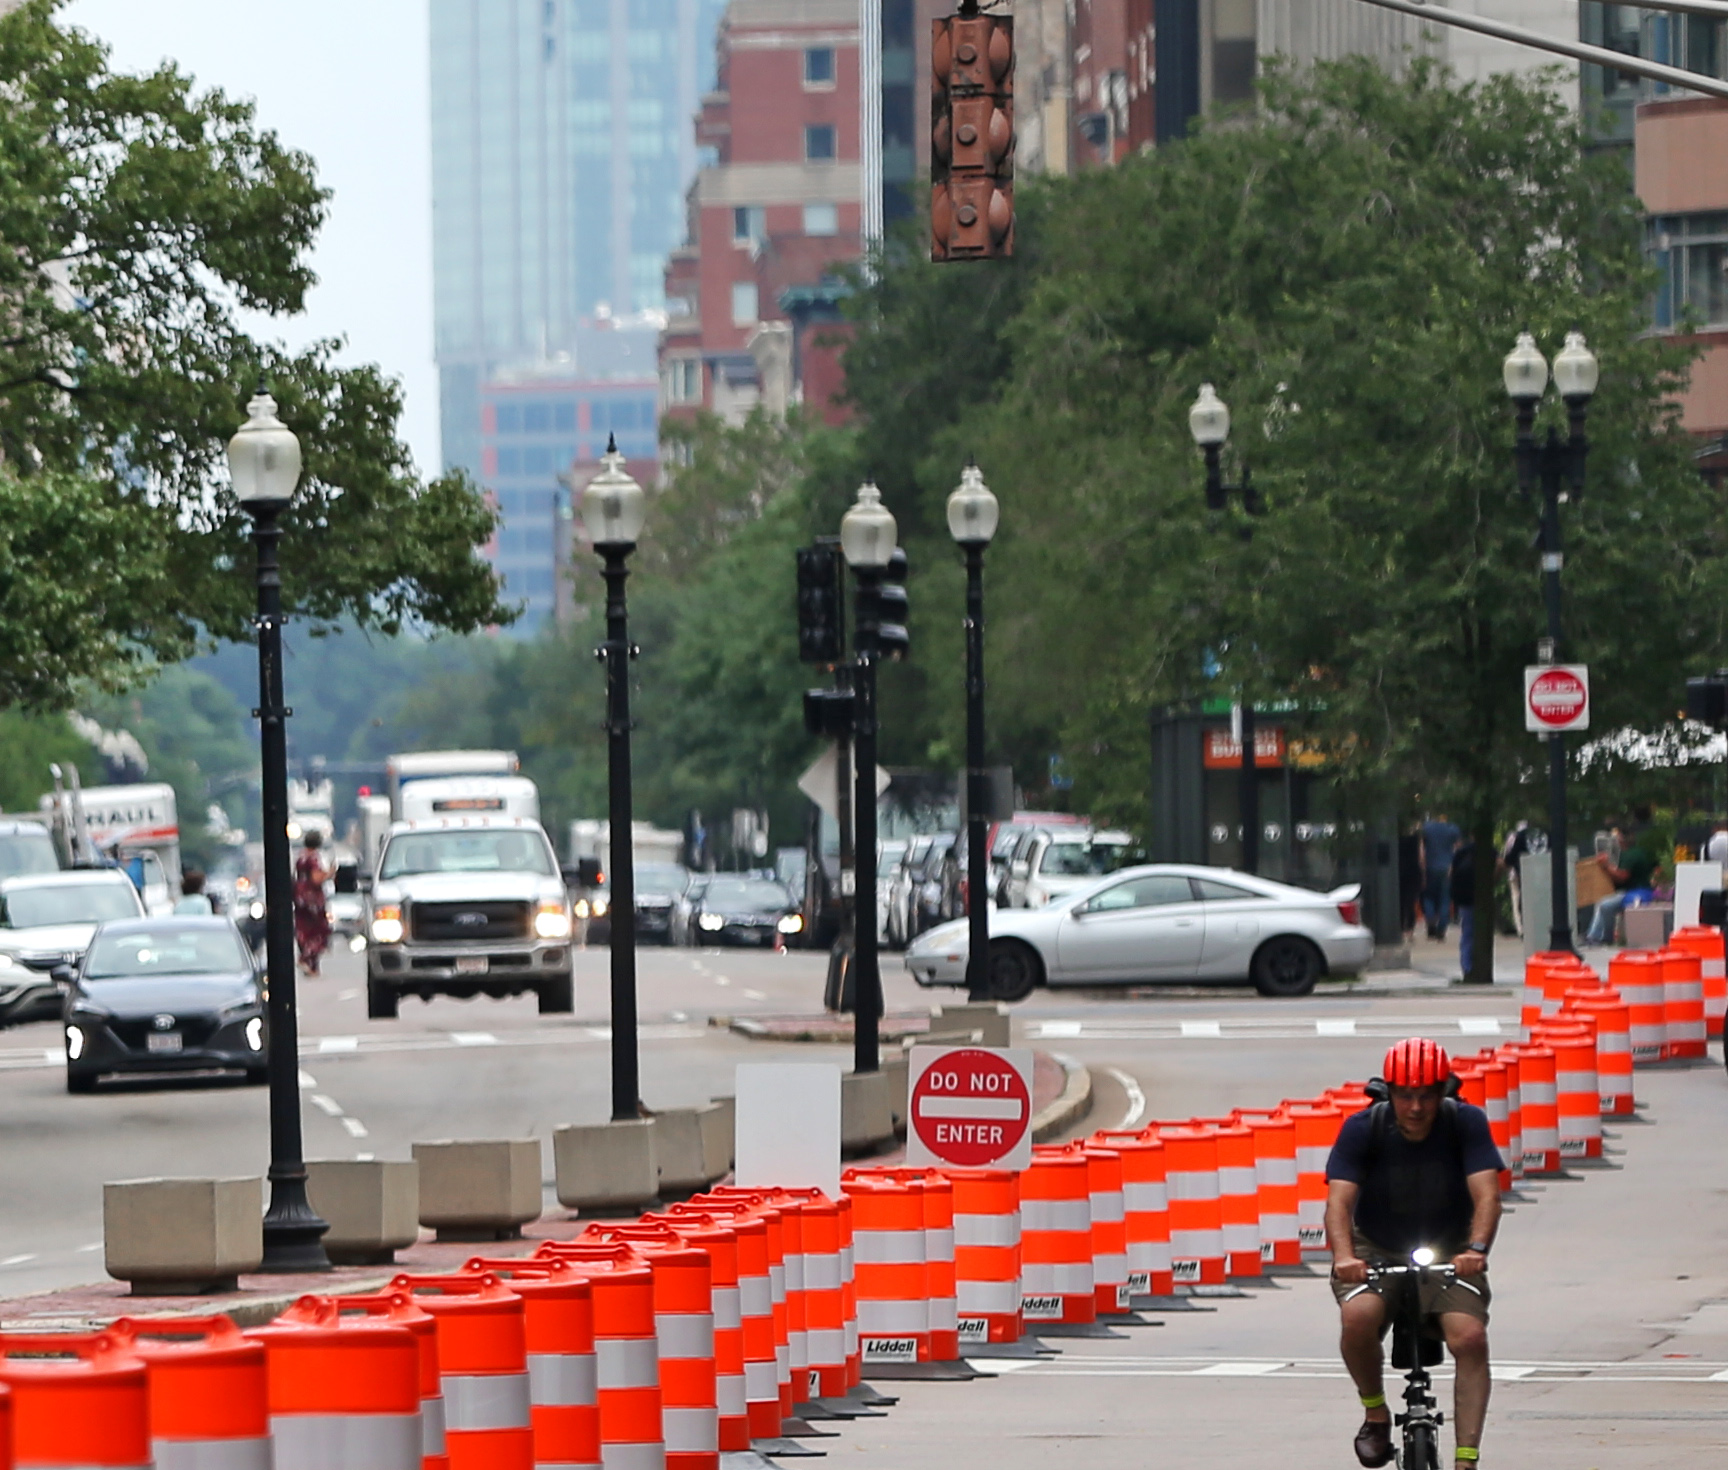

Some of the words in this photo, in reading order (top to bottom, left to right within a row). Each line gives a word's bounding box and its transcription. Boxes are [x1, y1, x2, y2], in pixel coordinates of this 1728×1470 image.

[1213, 745, 1277, 757] BURER
[930, 1072, 958, 1090] DO
[971, 1073, 1012, 1092] NOT
[936, 1124, 1003, 1144] ENTER
[1560, 1140, 1584, 1148] ddell
[1021, 1298, 1059, 1308] iddell
[957, 1320, 984, 1332] dell
[867, 1341, 914, 1352] Liddell
